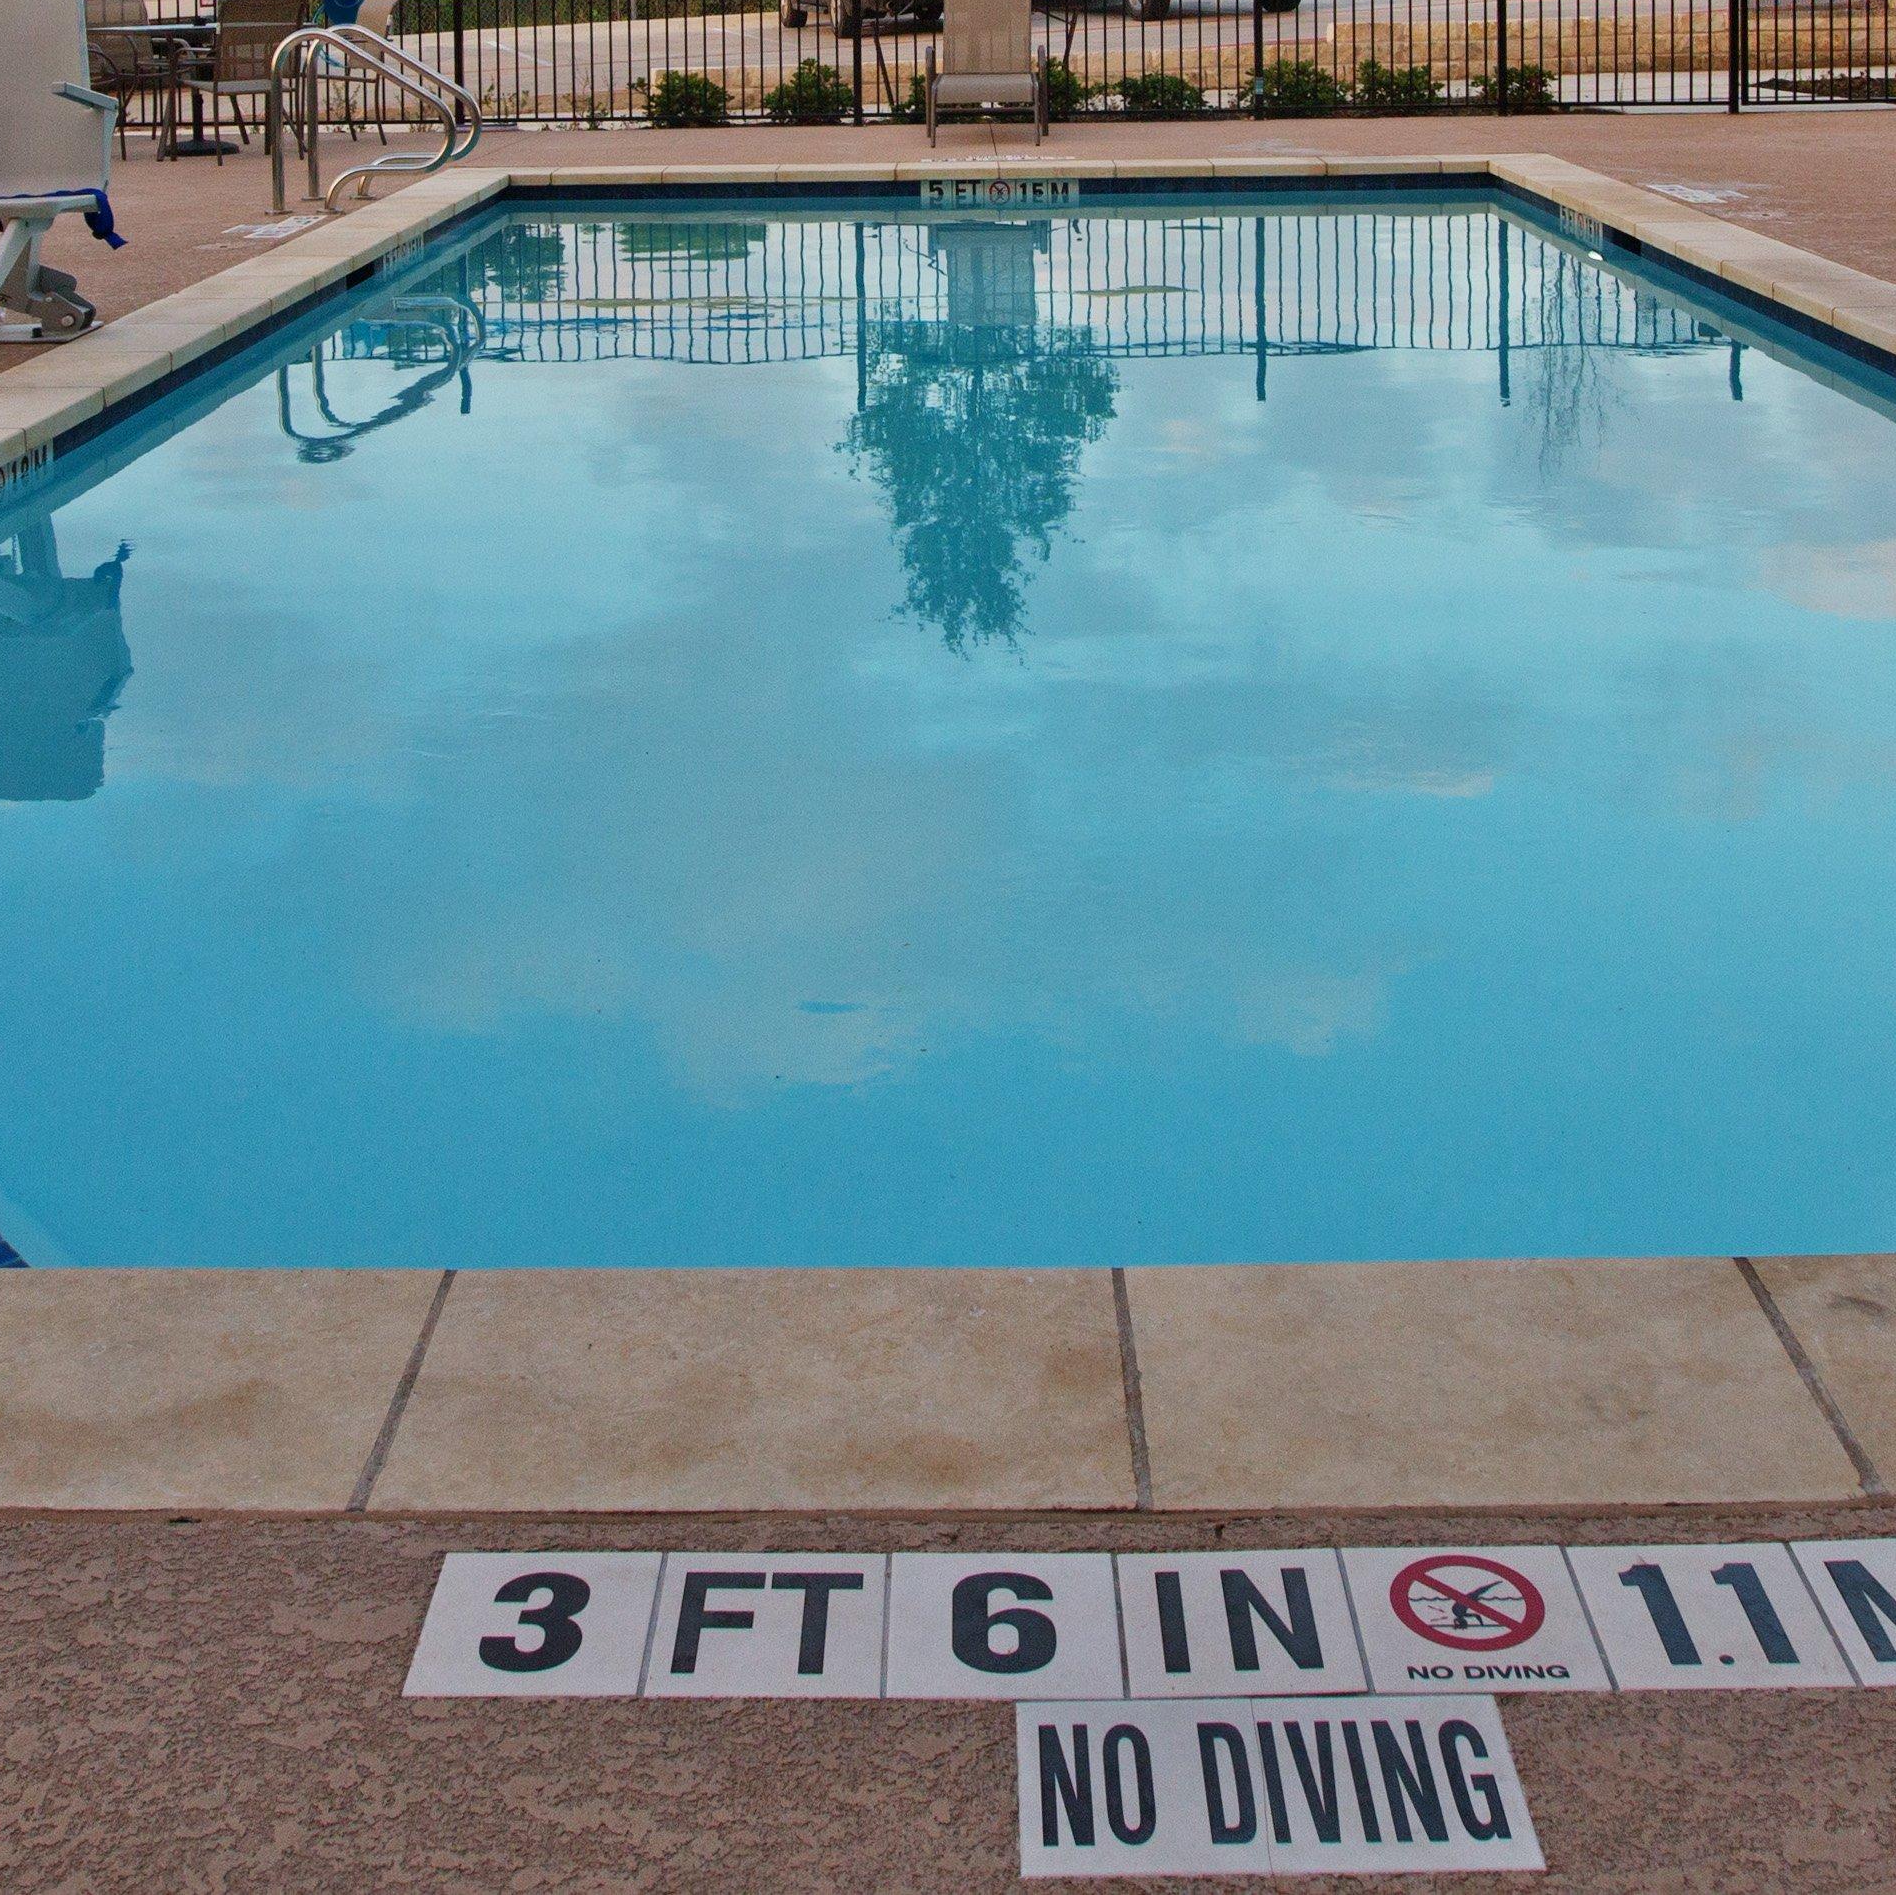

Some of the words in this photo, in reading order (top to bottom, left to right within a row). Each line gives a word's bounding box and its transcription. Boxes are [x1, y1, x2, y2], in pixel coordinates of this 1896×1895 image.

[929, 180, 945, 199] 5
[955, 180, 981, 198] FT
[1051, 182, 1070, 199] M
[478, 1570, 591, 1674] 3
[669, 1571, 865, 1675] FT
[950, 1571, 1058, 1674] 6
[1154, 1567, 1325, 1673] IN
[1618, 1561, 1802, 1667] 1.1
[1406, 1664, 1456, 1681] NO
[1462, 1663, 1571, 1681] DIVING
[1037, 1721, 1158, 1847] NO
[1197, 1718, 1513, 1846] DIVING
